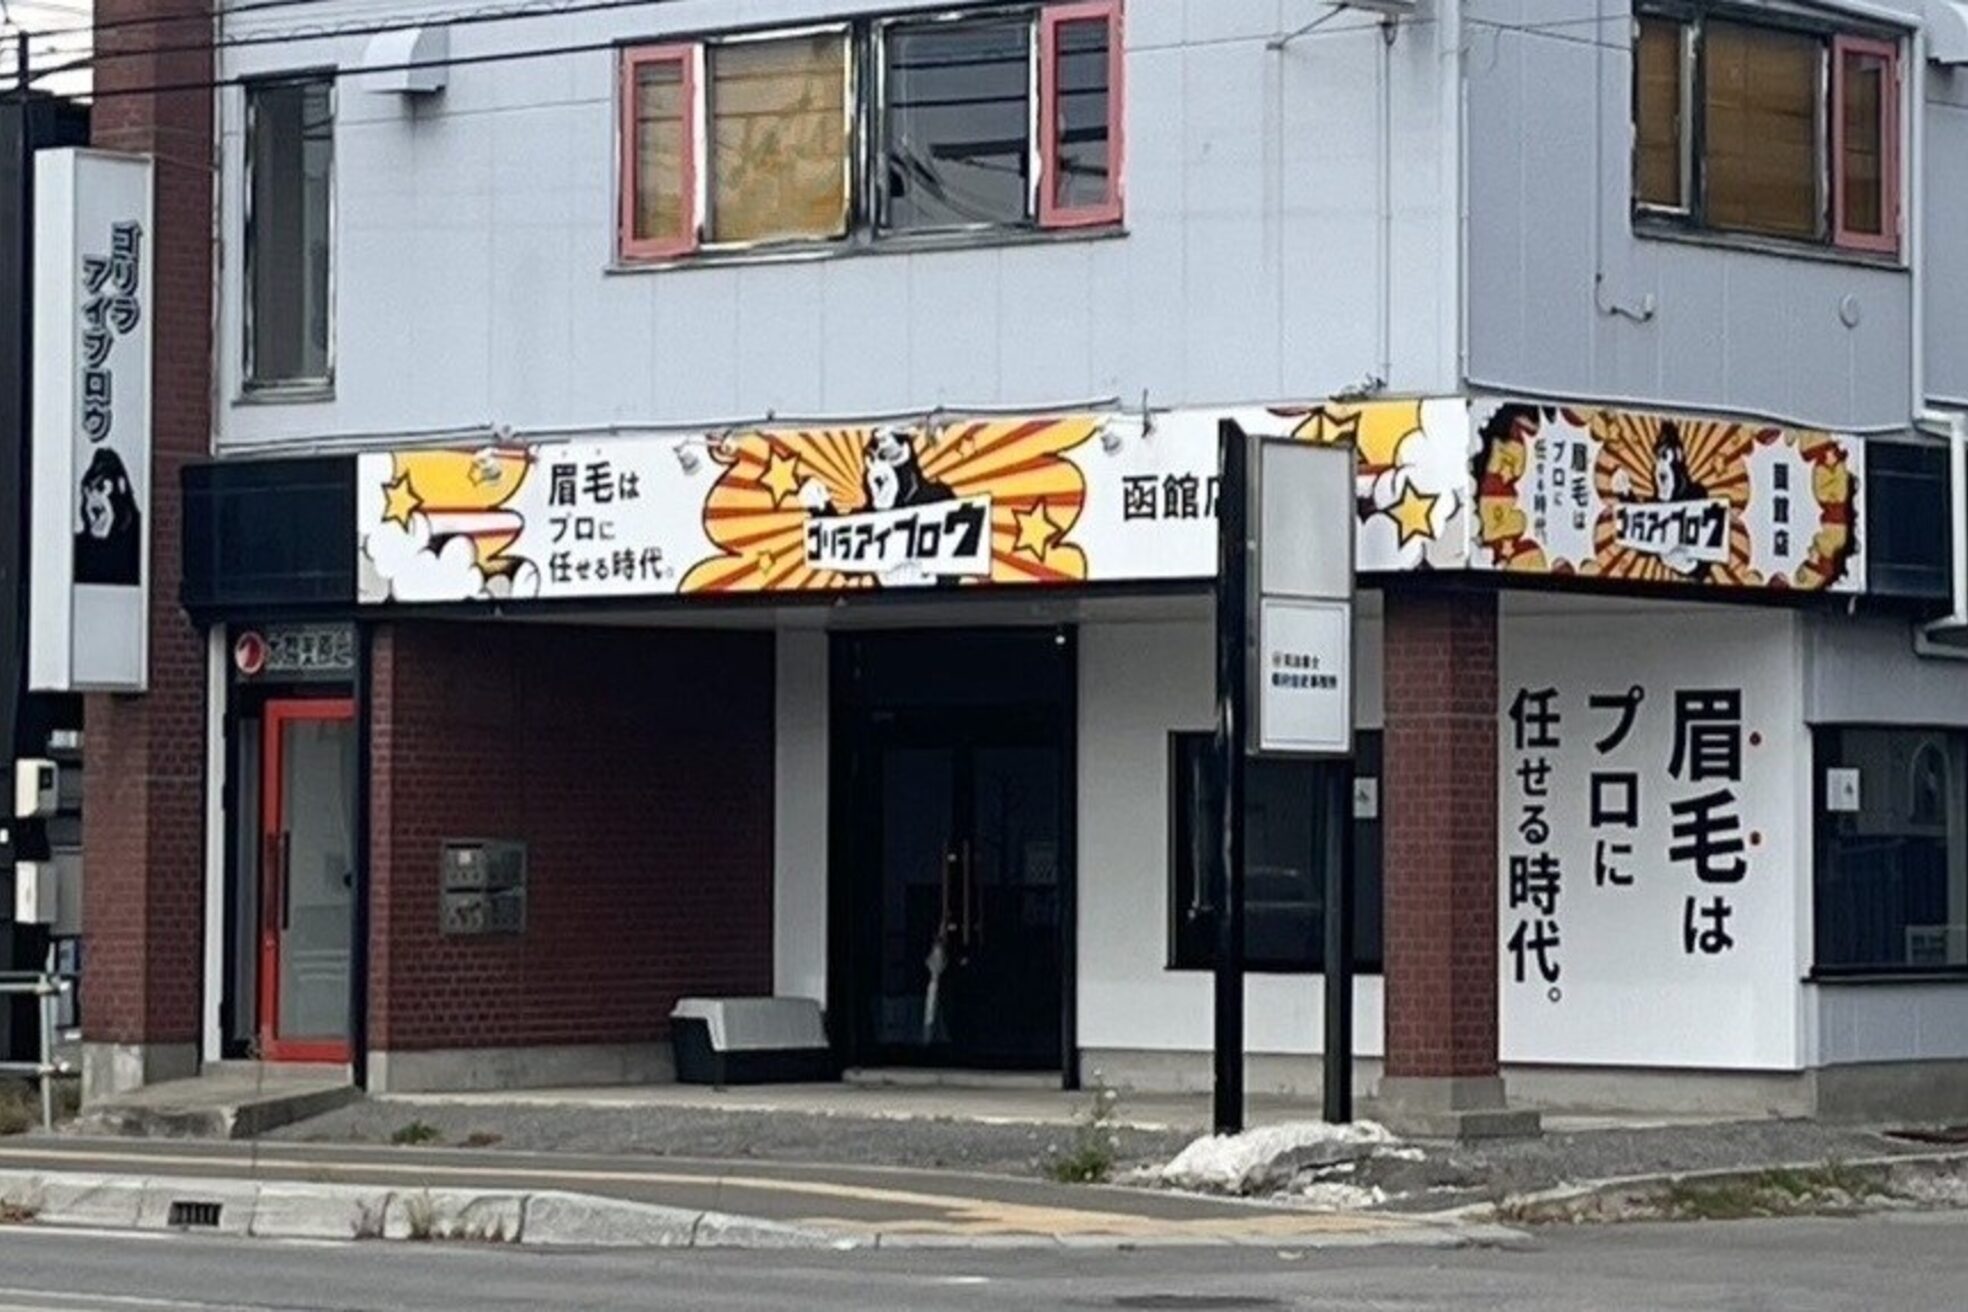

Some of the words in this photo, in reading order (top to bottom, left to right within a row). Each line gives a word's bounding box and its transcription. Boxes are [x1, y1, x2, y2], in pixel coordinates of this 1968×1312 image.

[548, 461, 640, 507] 眉毛は
[549, 512, 616, 543] プロに
[1507, 687, 1563, 1003] 任せる時代。
[1589, 684, 1645, 887] プロに
[1668, 689, 1747, 954] 眉毛は
